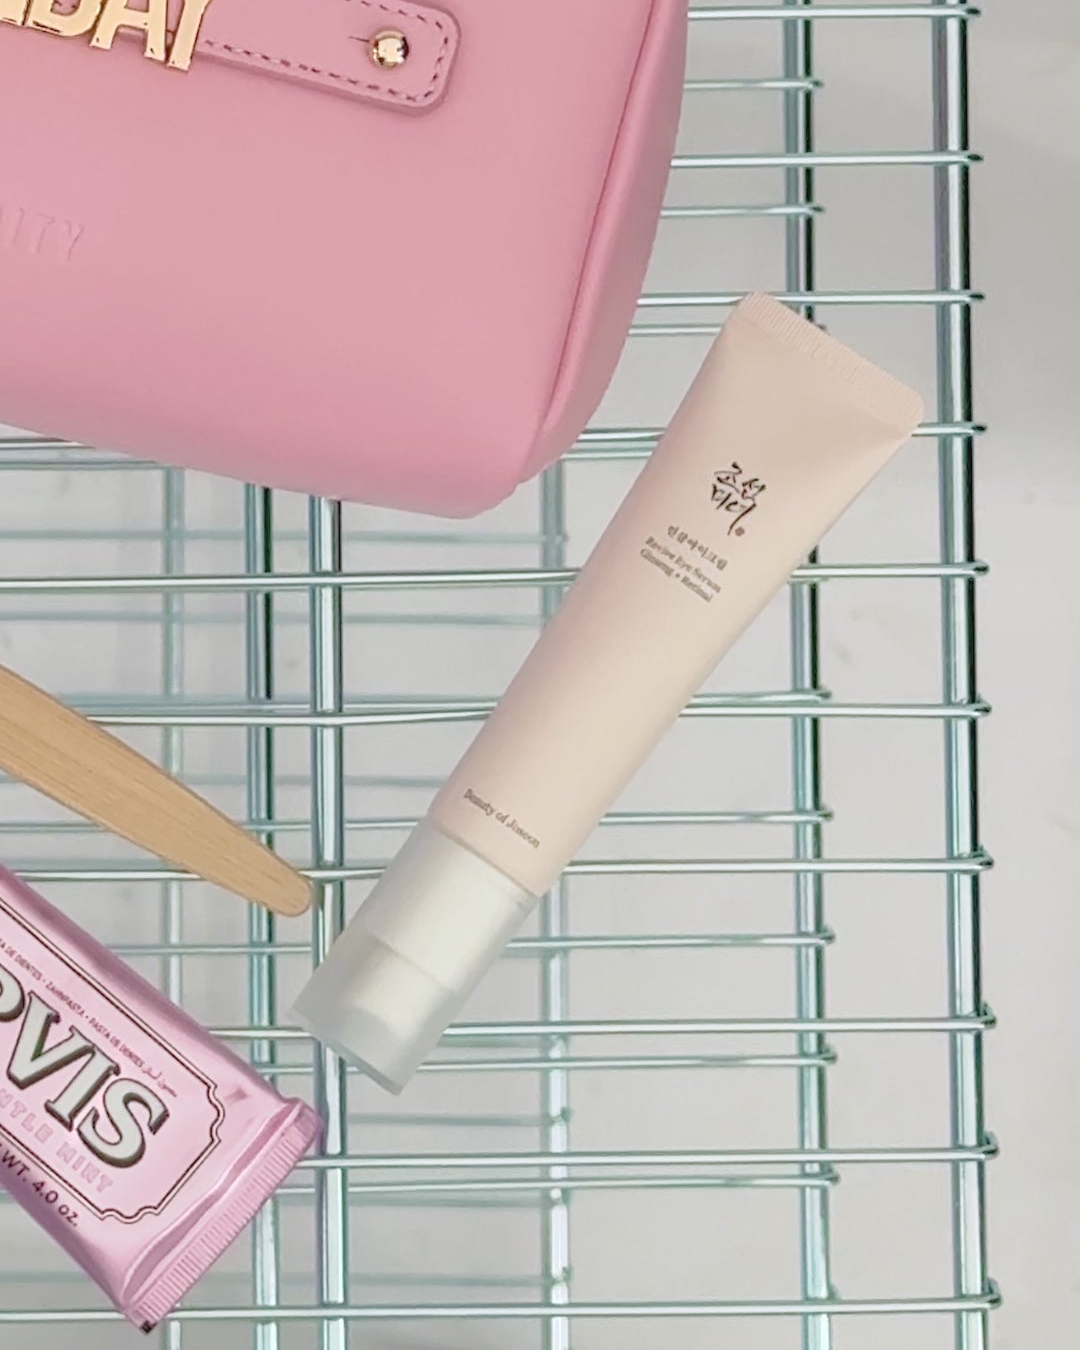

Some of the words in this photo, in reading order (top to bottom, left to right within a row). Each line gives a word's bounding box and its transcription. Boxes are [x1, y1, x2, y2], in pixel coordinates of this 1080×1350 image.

[1, 1149, 30, 1183] WT.
[32, 1180, 59, 1204] 4.0
[58, 1205, 79, 1227] oz.
[56, 1141, 115, 1193] MINT
